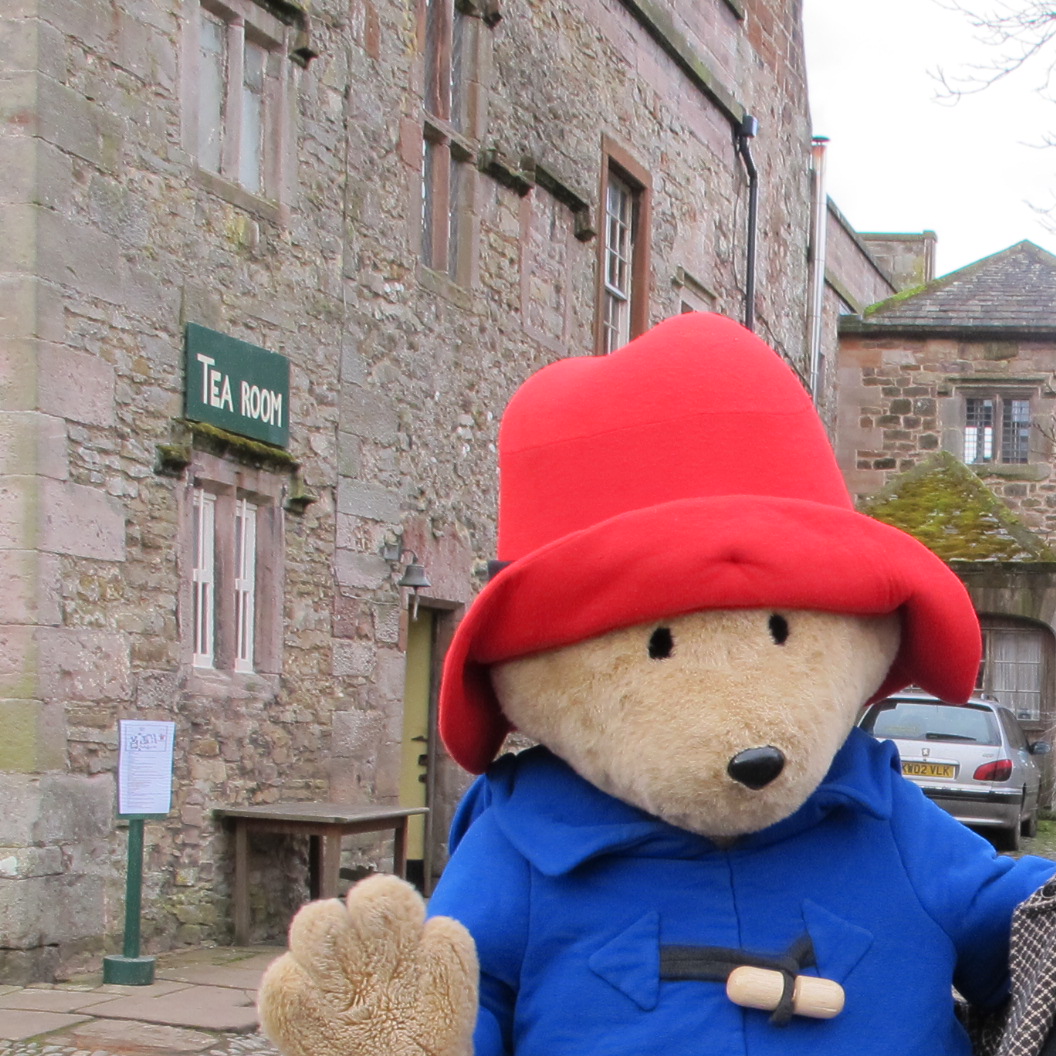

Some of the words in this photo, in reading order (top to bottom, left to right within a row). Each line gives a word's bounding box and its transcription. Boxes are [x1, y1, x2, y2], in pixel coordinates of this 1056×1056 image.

[197, 353, 234, 412] TEA
[241, 380, 282, 428] ROOM
[929, 764, 950, 777] VLK
